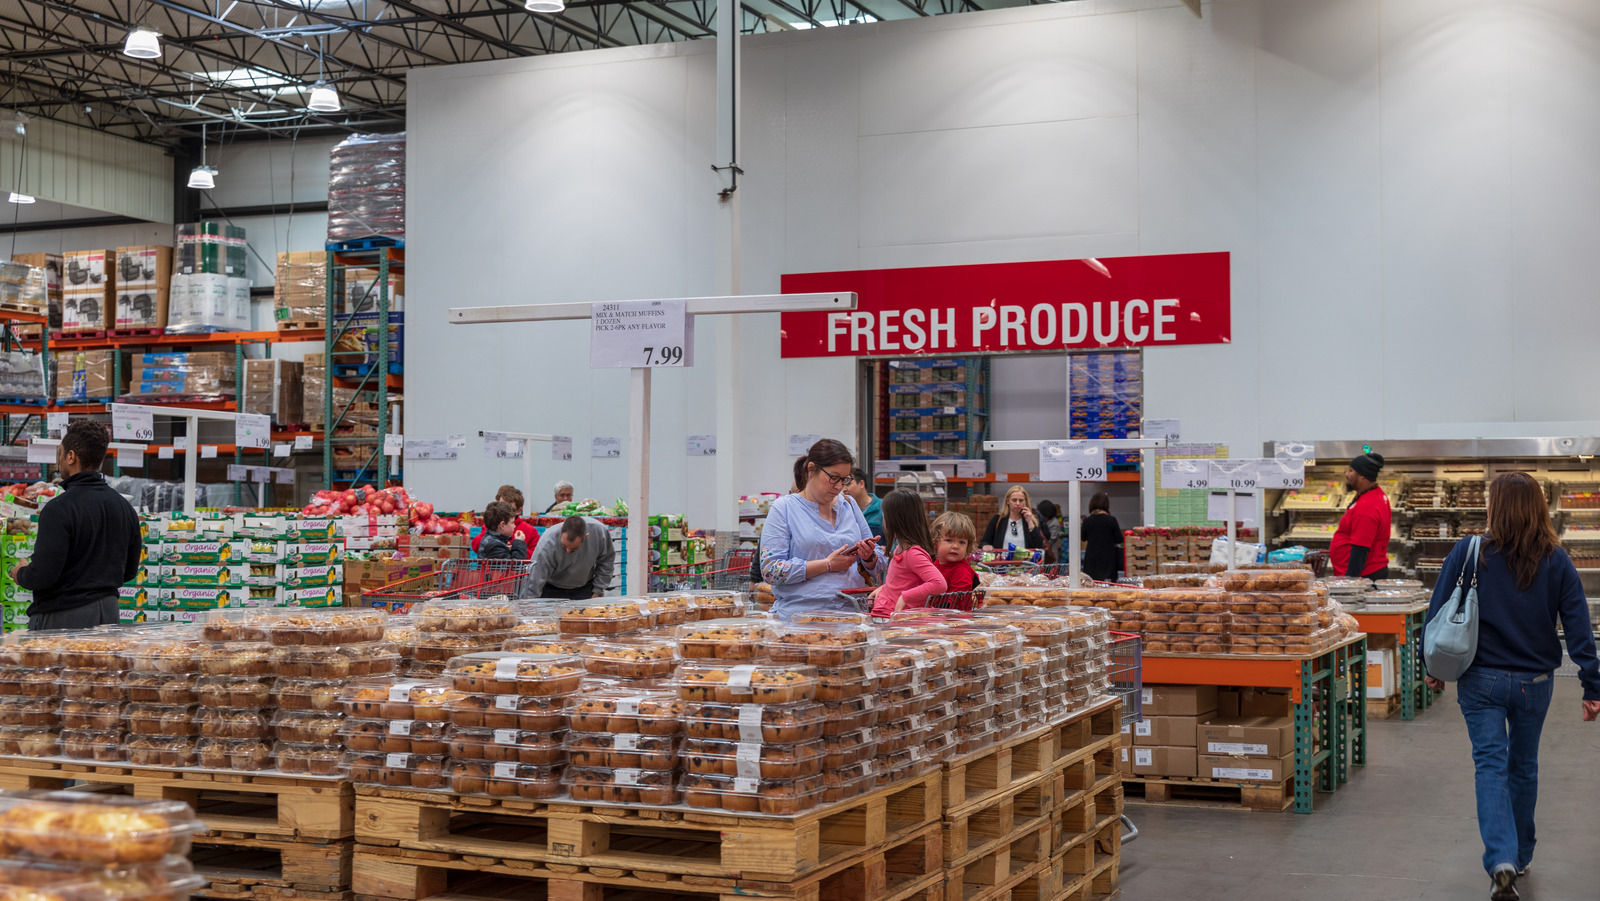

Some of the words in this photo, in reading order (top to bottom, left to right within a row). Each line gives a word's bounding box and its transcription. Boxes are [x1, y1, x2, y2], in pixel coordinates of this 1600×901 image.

[827, 307, 956, 352] FRESH
[972, 298, 1178, 348] PRODUCE
[643, 346, 683, 365] 7.99
[136, 430, 153, 439] 6.99
[255, 438, 270, 447] 1.99
[1075, 467, 1102, 479] 5.99
[1283, 479, 1303, 487] 9.99
[302, 520, 326, 530] Organic
[184, 543, 218, 553] Organic
[304, 544, 328, 553] Organic
[184, 566, 216, 576] Organic
[303, 568, 326, 577] Organic
[183, 589, 216, 599] Organic
[302, 589, 325, 598] Organic
